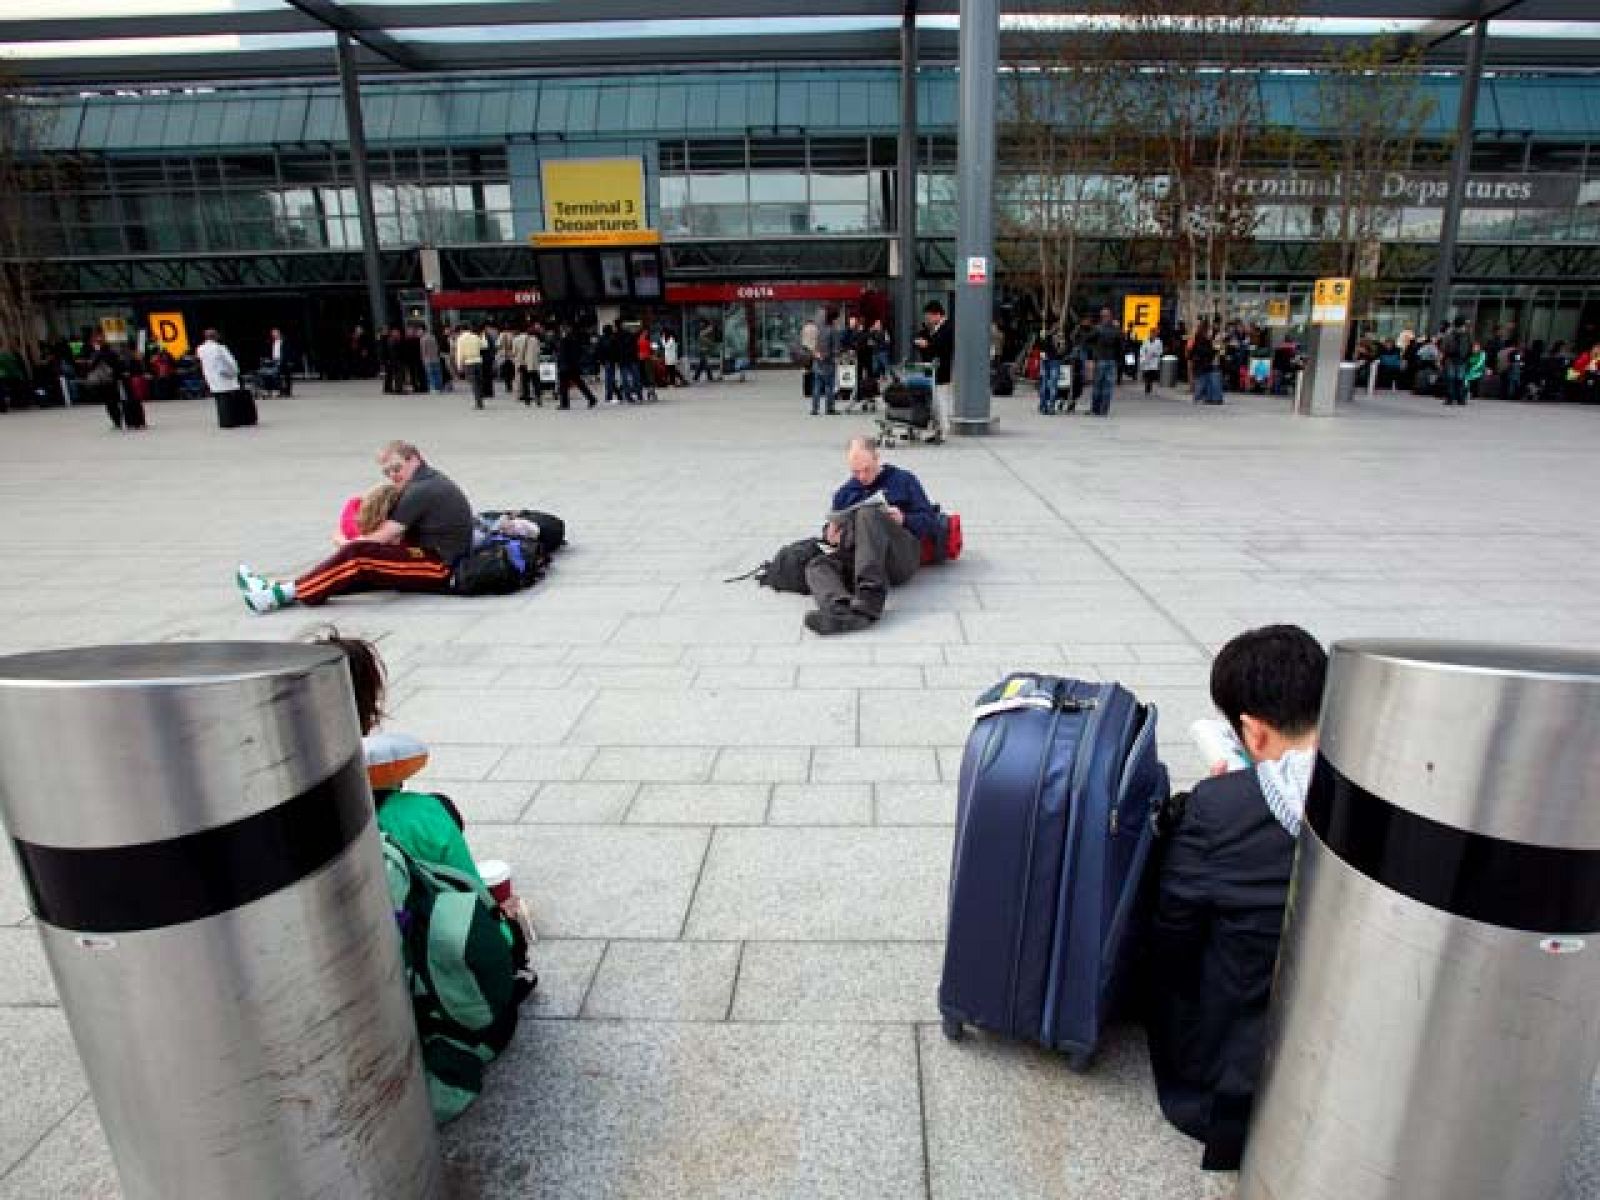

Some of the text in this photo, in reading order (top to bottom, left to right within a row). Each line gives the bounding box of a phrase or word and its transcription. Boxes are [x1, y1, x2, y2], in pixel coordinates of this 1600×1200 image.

[1381, 173, 1533, 205] Depatures
[554, 199, 634, 216] Terminal 3
[554, 218, 639, 232] Departures
[1135, 305, 1150, 325] E
[160, 320, 178, 342] D
